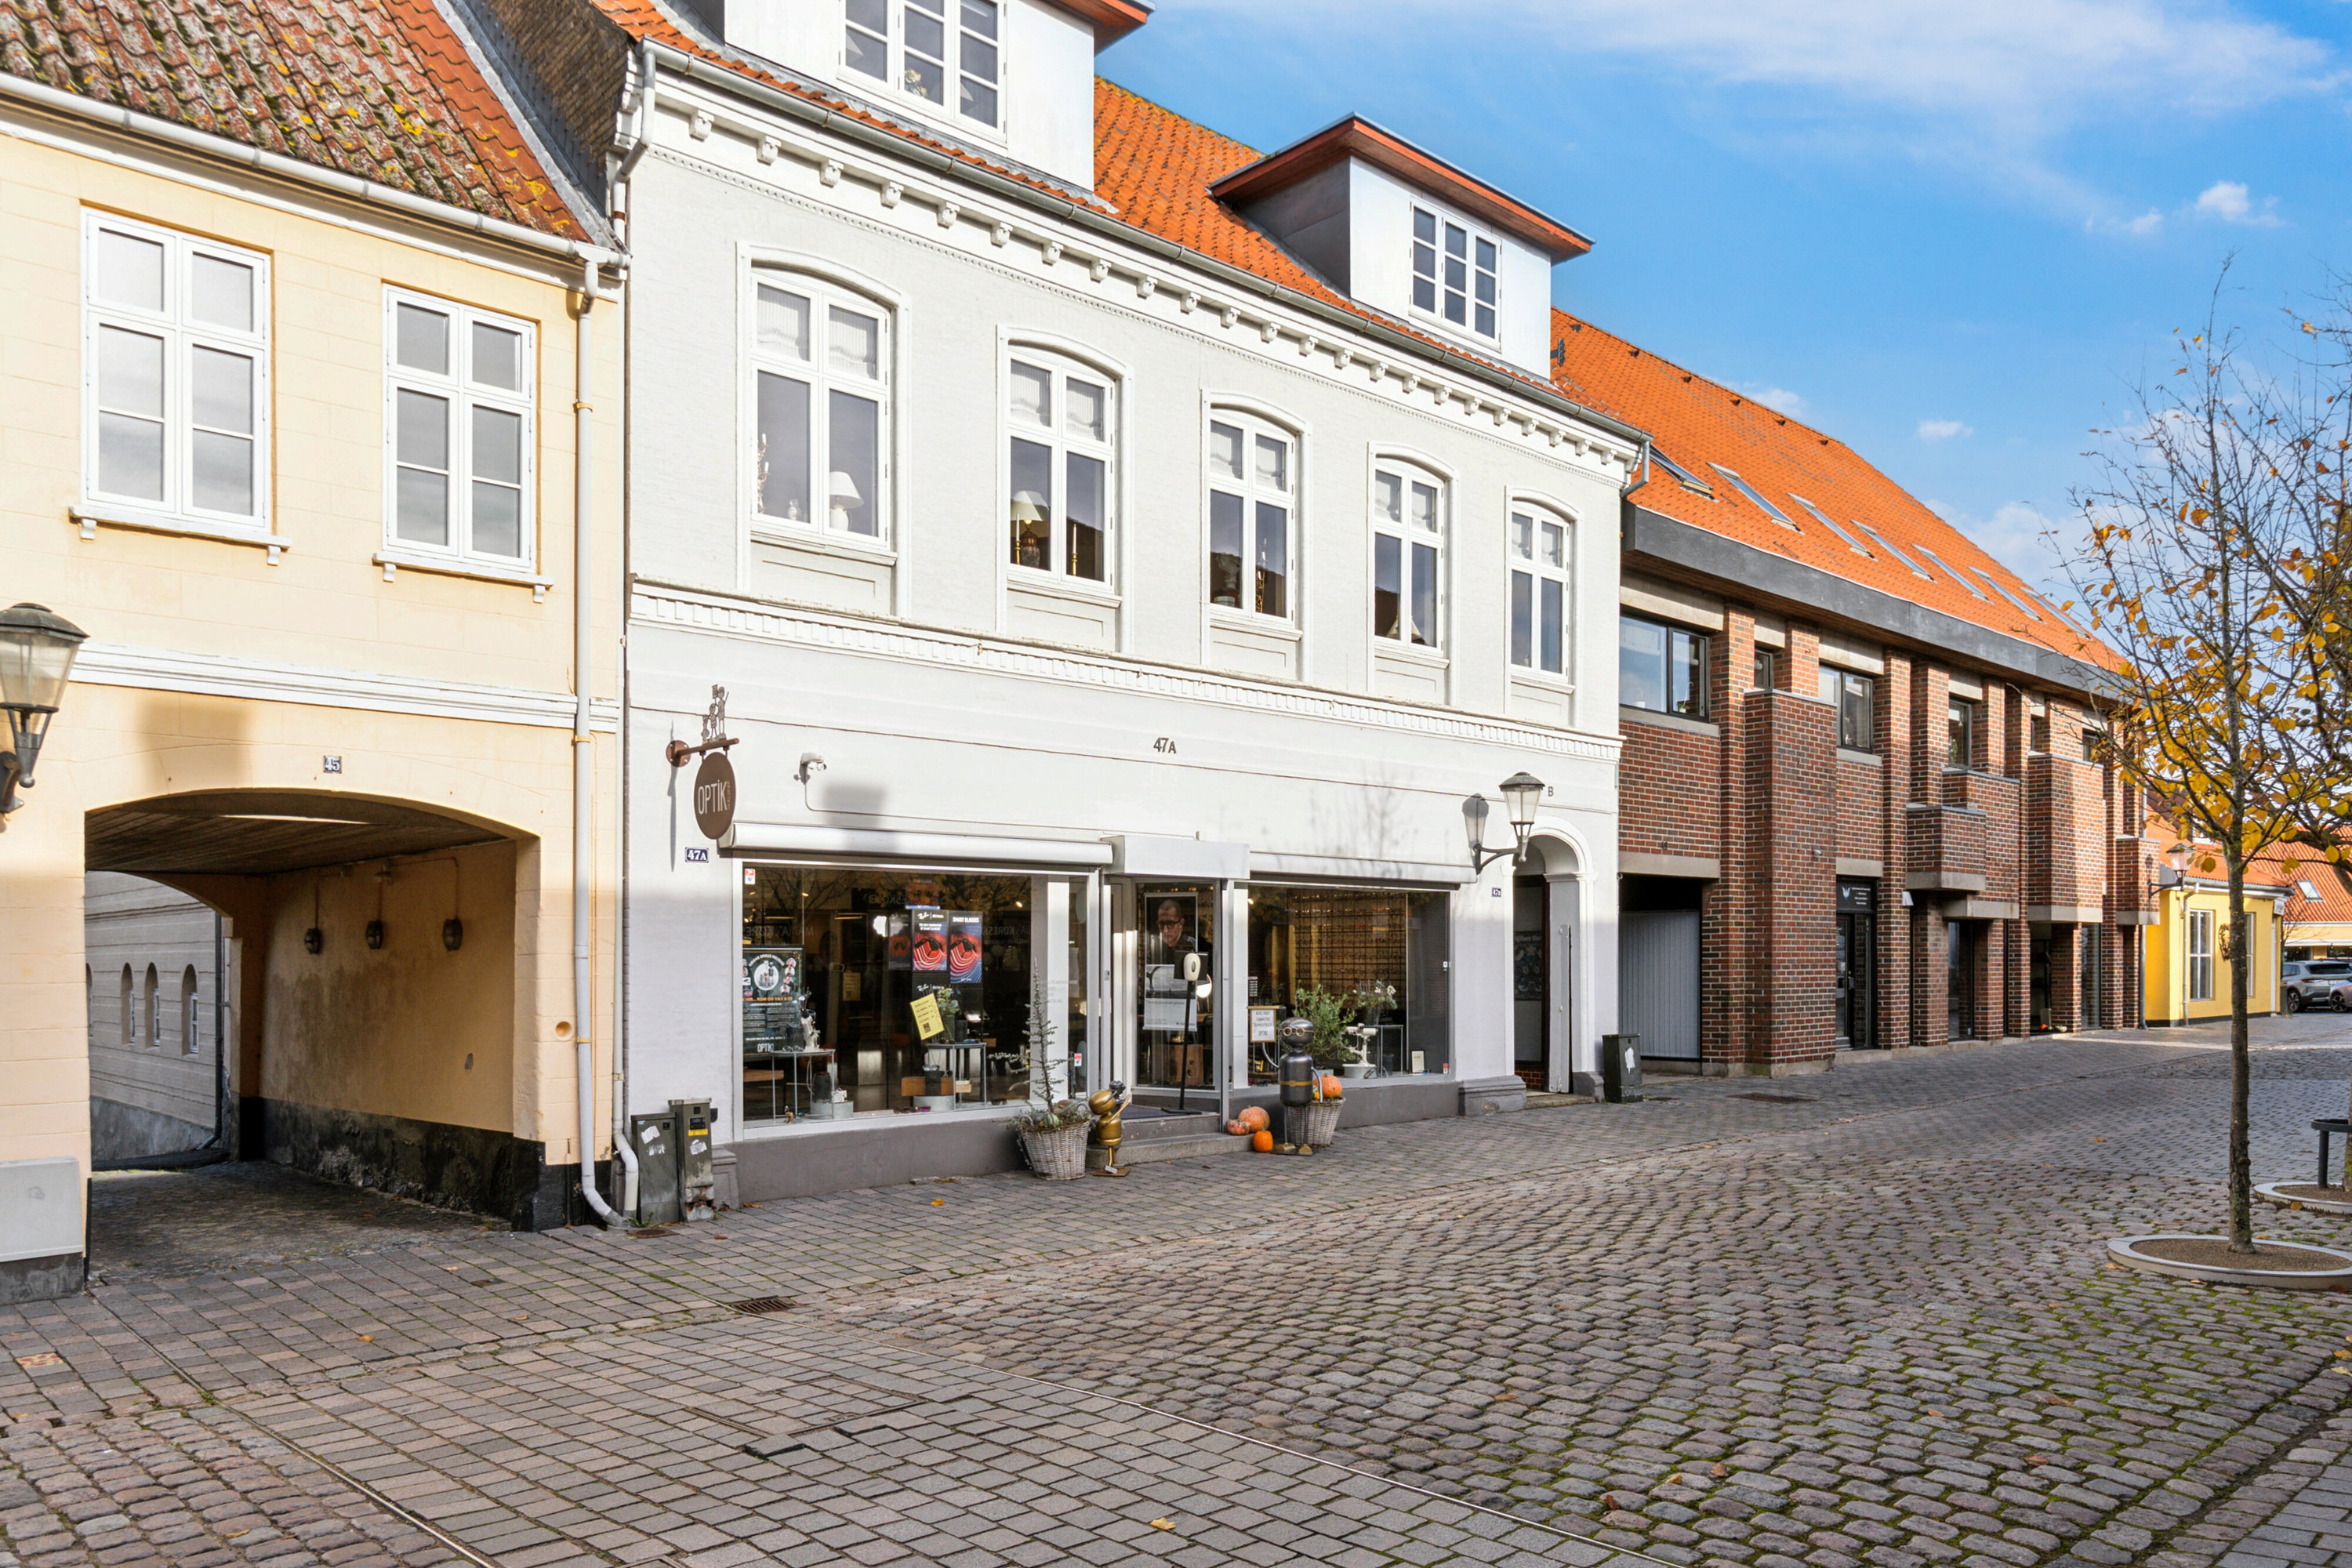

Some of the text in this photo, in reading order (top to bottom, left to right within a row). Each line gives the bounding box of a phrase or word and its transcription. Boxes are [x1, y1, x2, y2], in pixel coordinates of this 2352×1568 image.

[1153, 737, 1177, 754] 47A
[325, 757, 340, 771] 45
[1548, 786, 1554, 797] B
[688, 849, 706, 861] 47A
